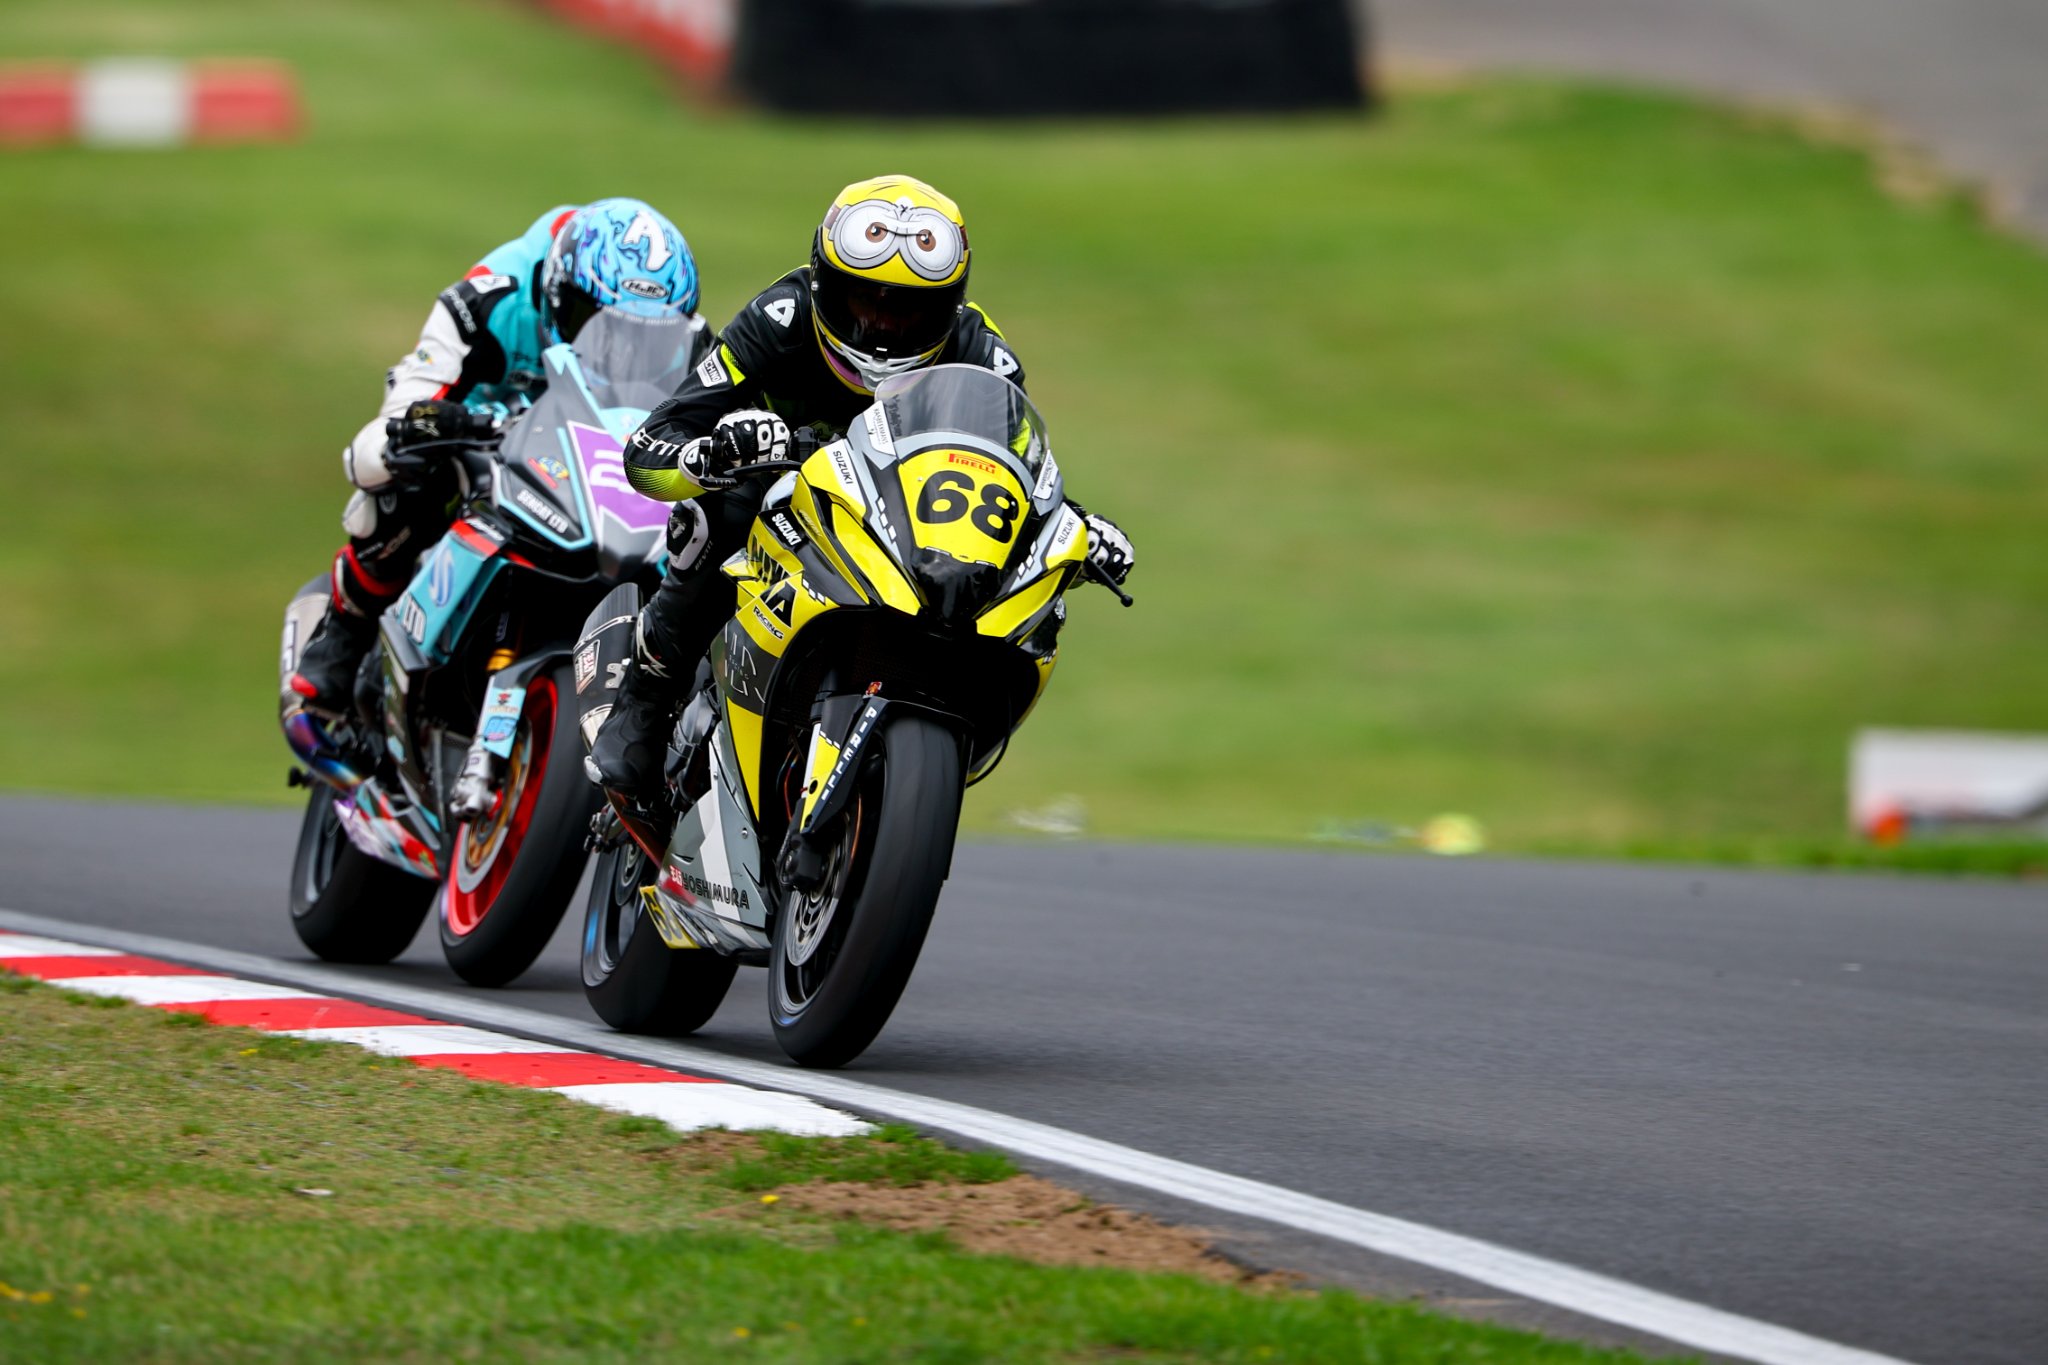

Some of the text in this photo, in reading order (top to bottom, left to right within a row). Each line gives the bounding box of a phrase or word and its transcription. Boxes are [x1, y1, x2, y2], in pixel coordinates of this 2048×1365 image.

[833, 450, 854, 485] SUZUKI
[949, 453, 996, 475] PIRELLI
[916, 470, 1020, 544] 68
[772, 513, 802, 546] SUZUKI
[1057, 517, 1077, 545] SUZUKI
[753, 605, 785, 640] RACING
[821, 706, 877, 801] PIRELLI
[682, 871, 750, 910] YOSHIMURA
